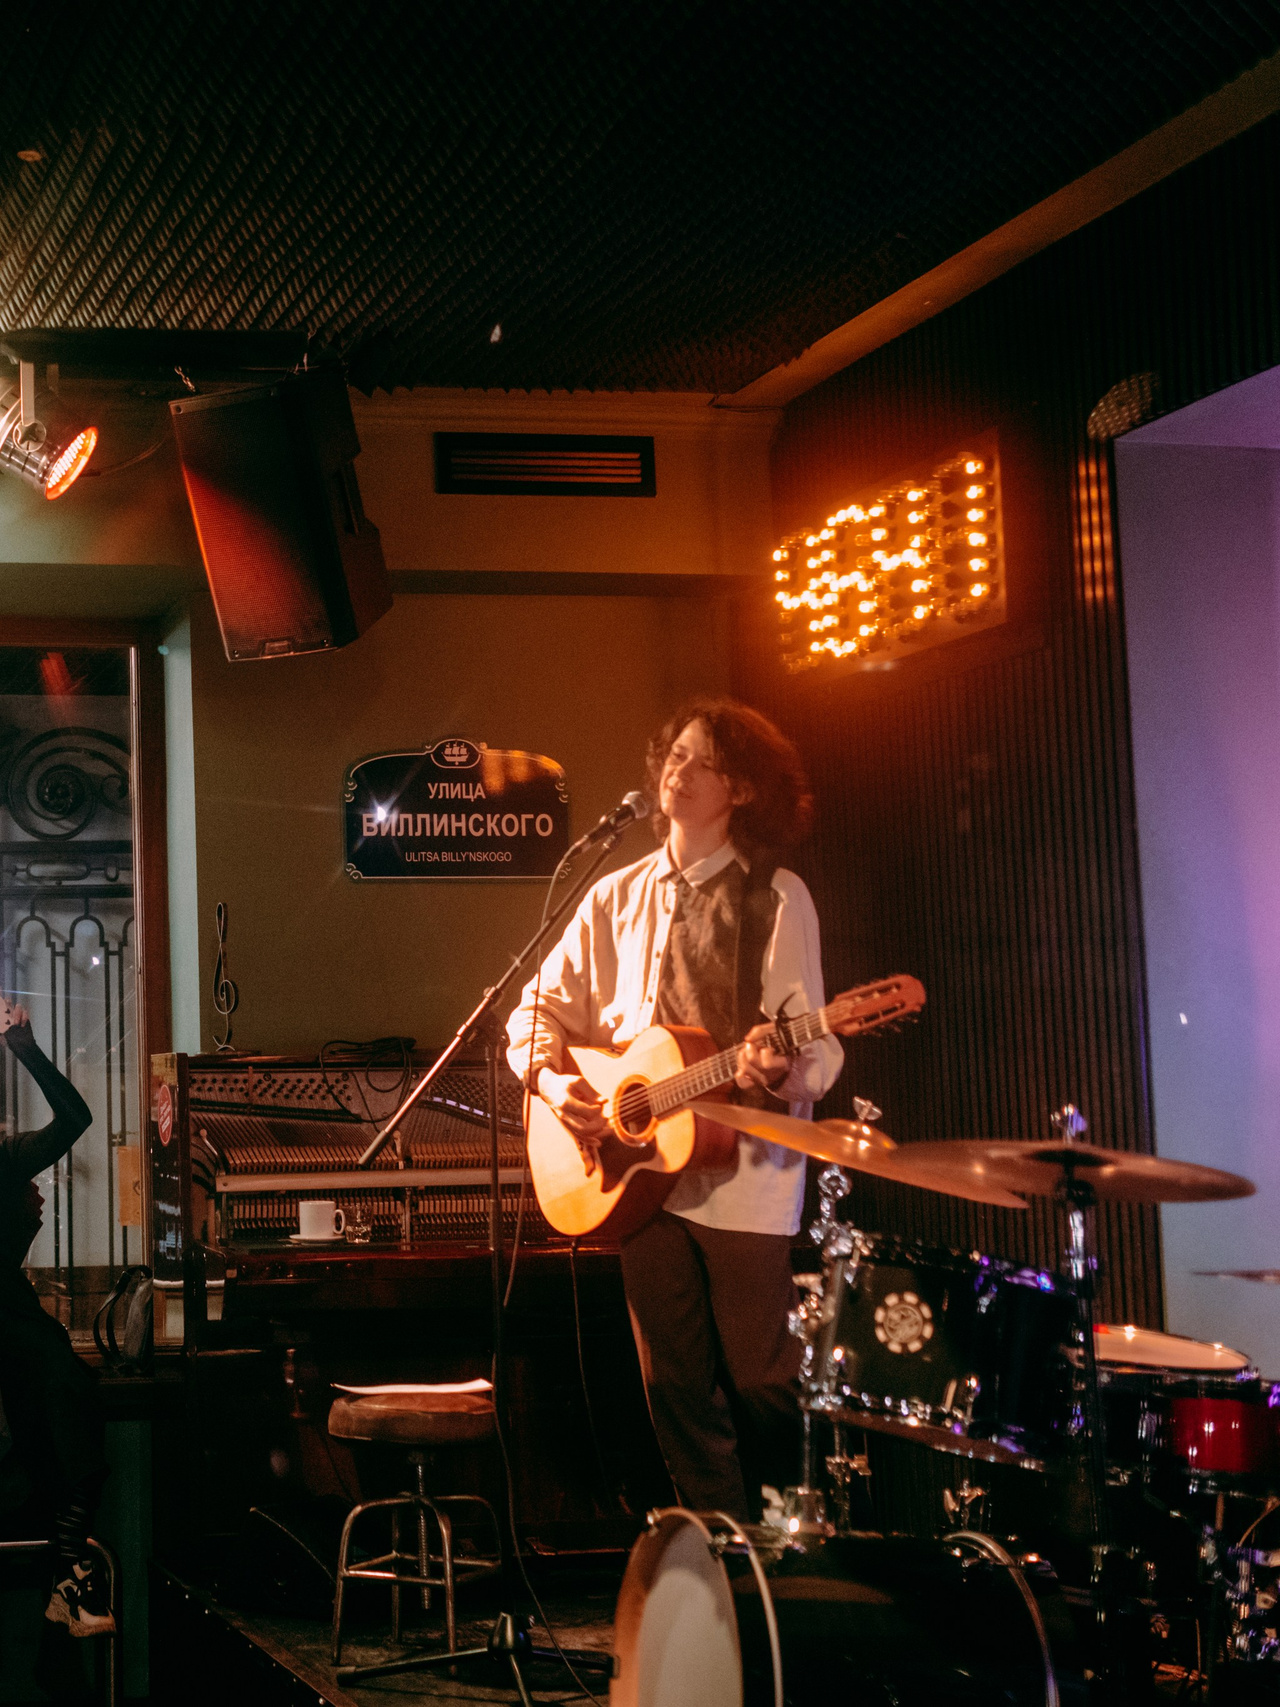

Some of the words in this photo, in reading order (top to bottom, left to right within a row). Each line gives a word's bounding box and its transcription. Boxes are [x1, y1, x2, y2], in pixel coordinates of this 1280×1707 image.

[427, 782, 486, 801] УЛИЦА
[362, 813, 554, 837] БИЛЛИНСКОГО
[405, 851, 439, 862] ULITSA
